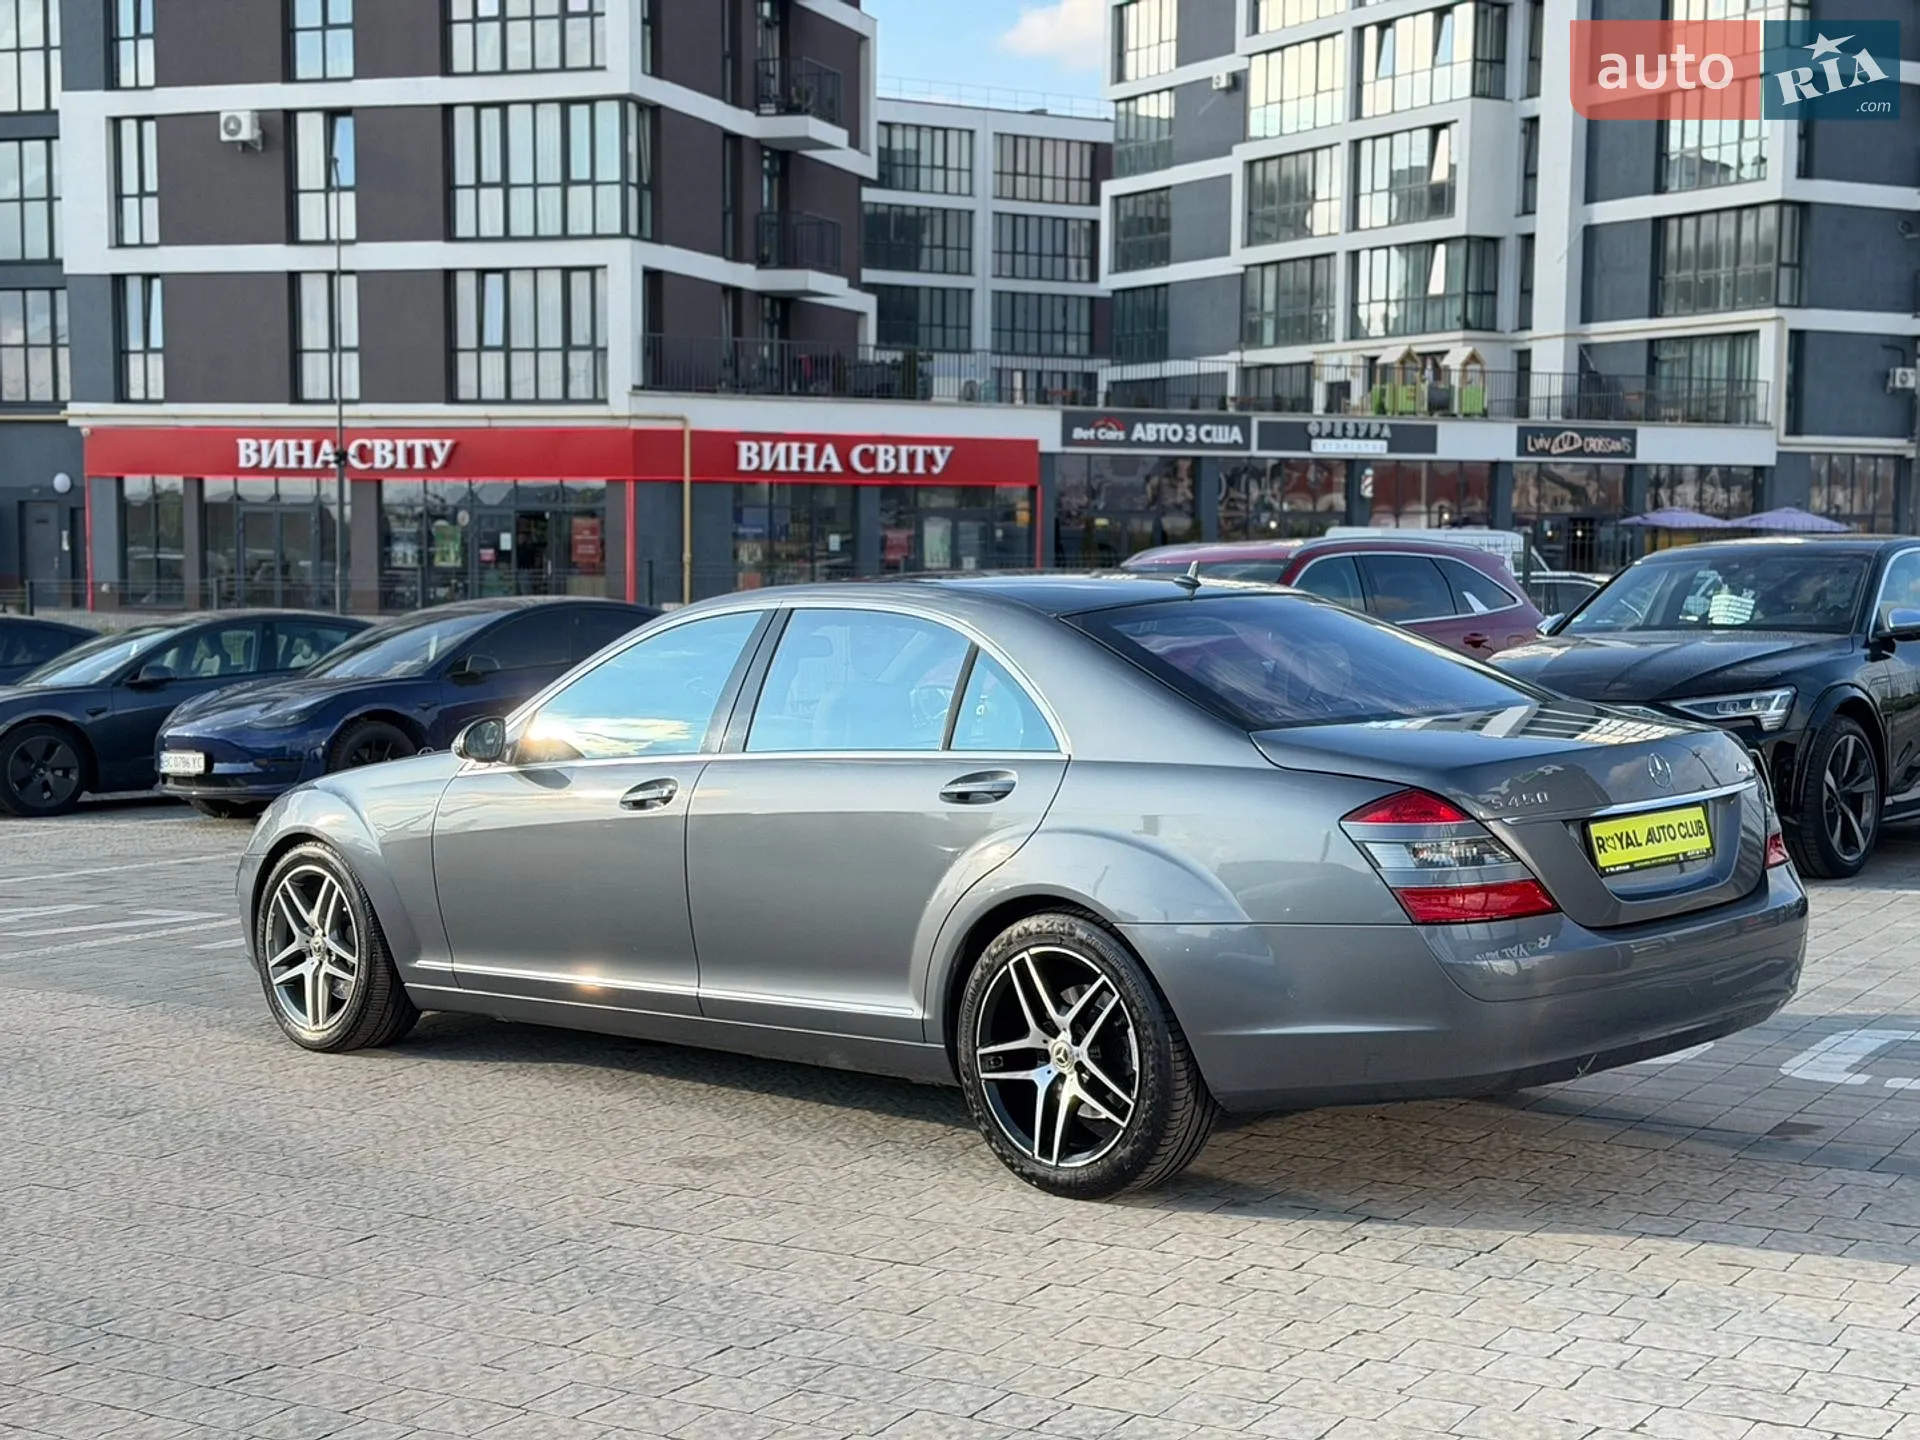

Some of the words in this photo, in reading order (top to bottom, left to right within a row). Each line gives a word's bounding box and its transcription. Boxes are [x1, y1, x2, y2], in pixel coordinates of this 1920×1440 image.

[1097, 427, 1125, 441] Cars
[1131, 422, 1183, 443] АВТО
[1199, 425, 1243, 444] США
[236, 438, 337, 468] ВИНА
[348, 438, 454, 469] СВІТУ
[736, 440, 843, 473] ВИНА
[850, 443, 954, 474] СВІТУ
[1645, 823, 1677, 845] AUTO
[1677, 819, 1705, 839] CLUB
